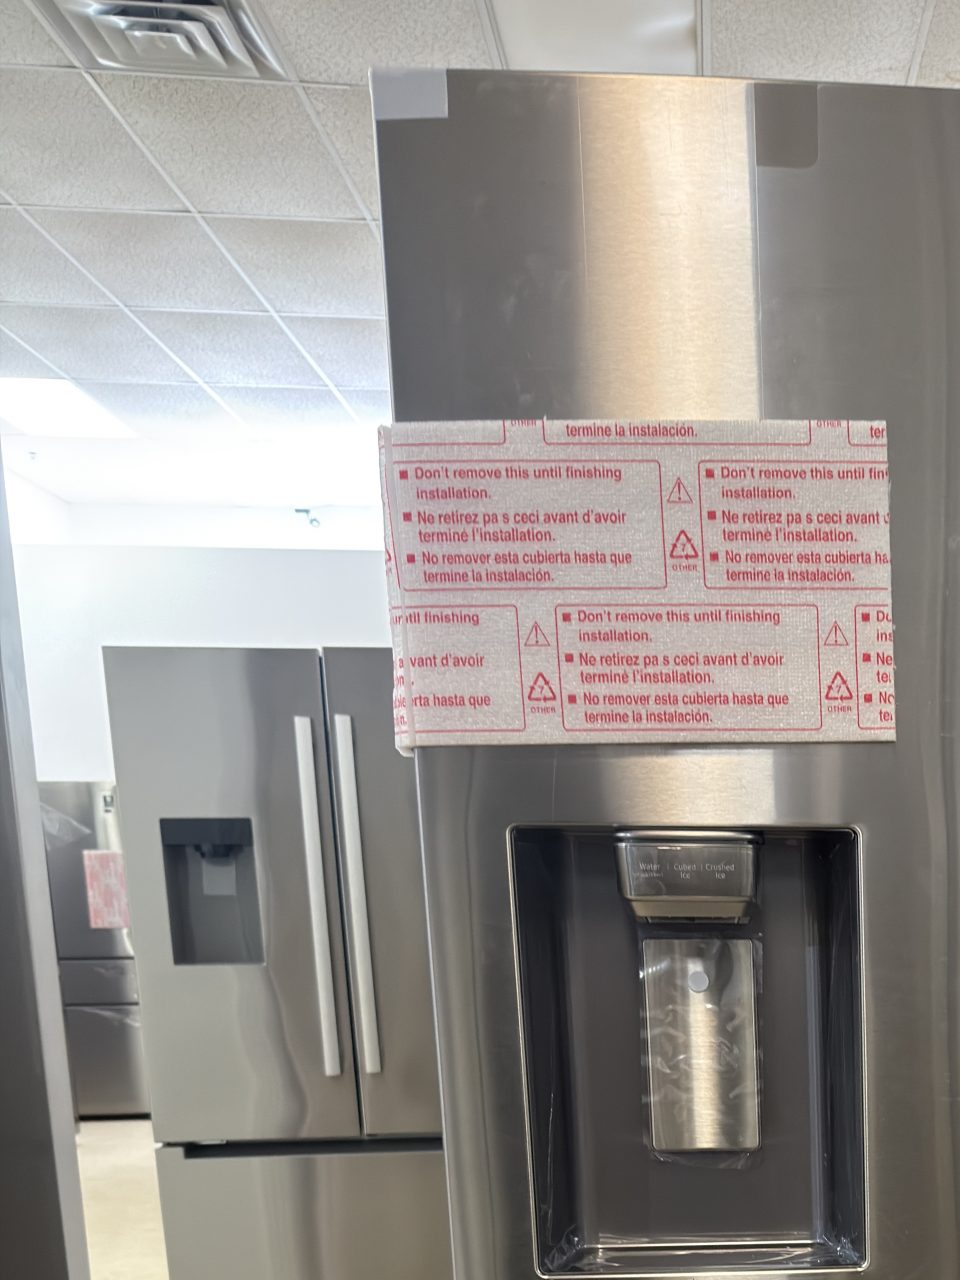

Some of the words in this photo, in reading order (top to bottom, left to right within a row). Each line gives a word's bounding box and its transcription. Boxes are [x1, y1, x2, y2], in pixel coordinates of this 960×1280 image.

[566, 422, 612, 437] termine
[615, 422, 625, 437] la
[629, 422, 697, 437] instalación.
[415, 466, 449, 479] Don't
[453, 469, 501, 479] remove
[505, 466, 529, 479] this
[533, 466, 562, 479] until
[566, 466, 622, 482] finishing
[416, 487, 491, 499] installation.
[721, 486, 796, 498] installation.
[417, 511, 434, 524] Ne
[438, 511, 478, 524] retirez
[483, 514, 498, 527] pa
[502, 514, 509, 524] s
[513, 511, 539, 524] ceci
[543, 512, 578, 524] avant
[582, 511, 626, 523] d'avoir
[418, 530, 468, 542] terminé
[472, 529, 556, 542] l'installation.
[722, 529, 771, 542] terminé
[775, 529, 857, 542] l'installation.
[422, 552, 438, 565] No
[442, 554, 491, 564] remover
[494, 553, 519, 564] esta
[522, 552, 571, 564] cubierta
[574, 552, 606, 564] hasta
[610, 554, 632, 567] que
[424, 569, 468, 582] termine
[472, 569, 482, 582] la
[486, 569, 554, 582] instalación.
[578, 610, 611, 622] Don't
[615, 612, 663, 622] remove
[666, 610, 690, 622] this
[694, 610, 721, 622] until
[726, 609, 780, 625] finishing
[579, 629, 652, 642] installation.
[579, 653, 596, 666] Ne
[600, 653, 639, 666] retirez
[643, 656, 659, 668] pa
[663, 656, 670, 665] s
[674, 653, 699, 665] ceci
[703, 654, 737, 665] avant
[741, 653, 784, 665] d'avoir
[580, 671, 628, 683] terminé
[632, 670, 714, 683] l'installation.
[583, 692, 599, 705] No
[603, 695, 651, 705] remover
[654, 693, 679, 705] esta
[682, 692, 729, 705] cubierta
[732, 692, 764, 704] hasta
[768, 694, 789, 708] que
[584, 710, 629, 723] termine
[632, 710, 642, 722] la
[646, 710, 712, 722] instalación.
